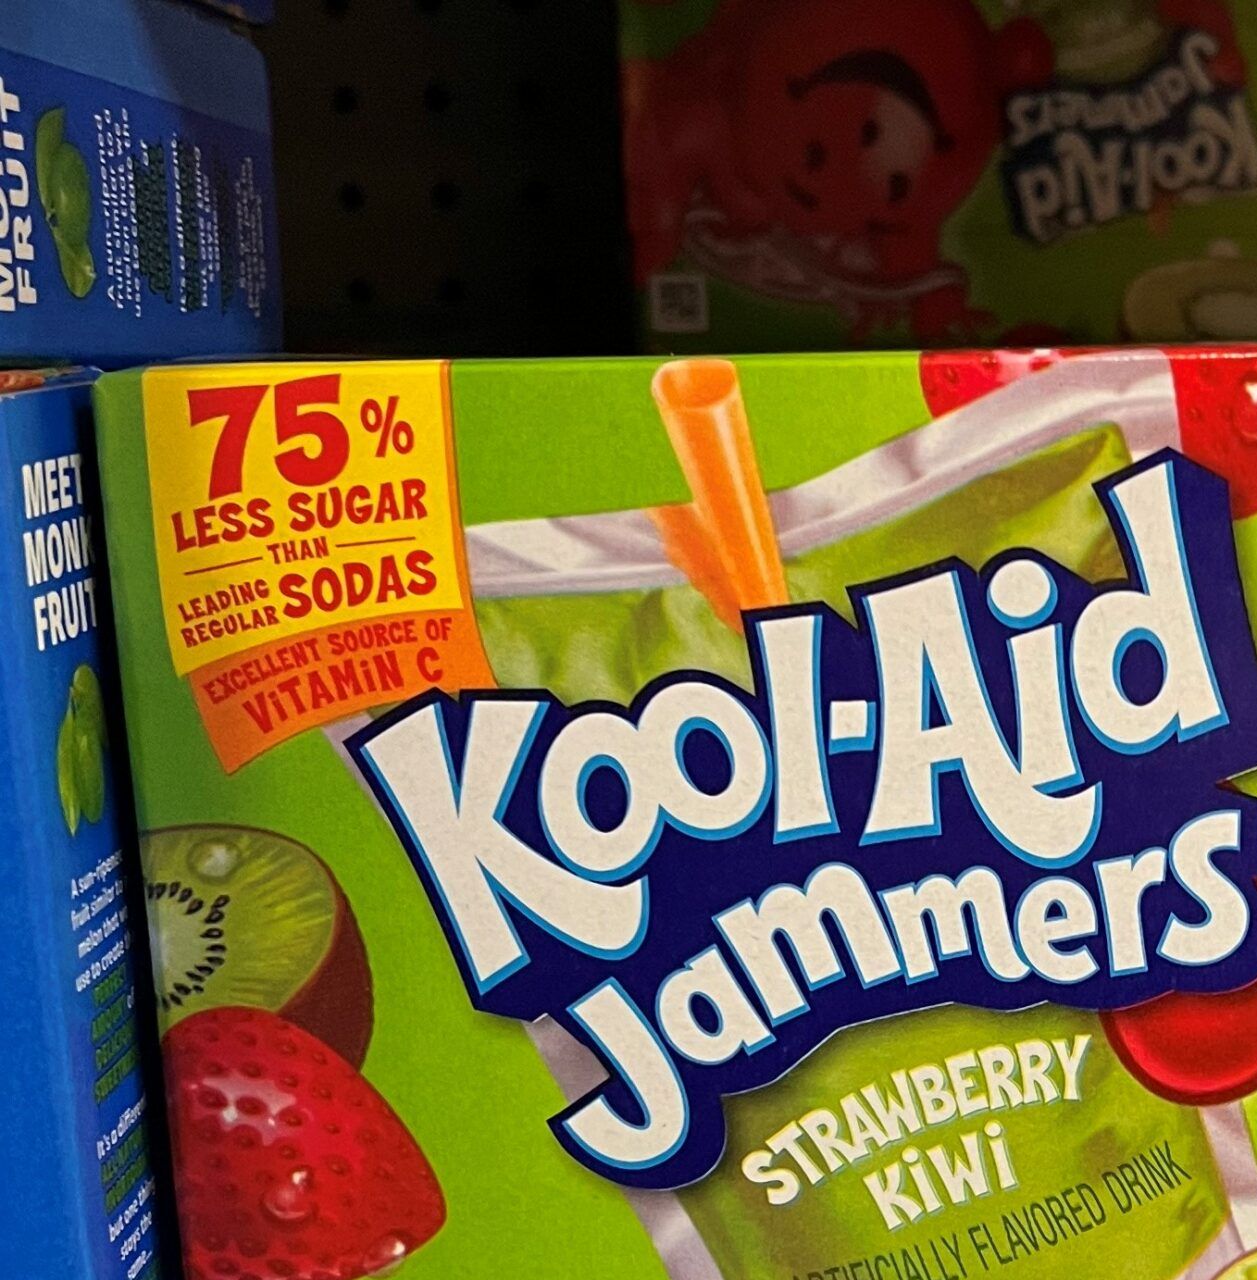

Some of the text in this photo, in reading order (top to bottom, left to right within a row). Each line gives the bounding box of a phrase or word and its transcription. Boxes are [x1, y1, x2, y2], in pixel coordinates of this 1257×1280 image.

[1005, 32, 1218, 145] Jammers
[22, 453, 83, 518] MEET
[171, 478, 428, 552] LESS SUGAR
[268, 536, 329, 565] THAN
[279, 550, 437, 619] SODAS
[180, 605, 280, 648] REGULAR
[202, 617, 453, 705] EXCELLENT SOURCE OF
[417, 646, 444, 683] C
[355, 461, 1231, 996] Kool-Aid
[563, 810, 1250, 1170] Jammers
[741, 1035, 1092, 1206] STRAWBERRY
[974, 1182, 1106, 1270] FLAVORED
[1103, 1140, 1192, 1216] DRINK
